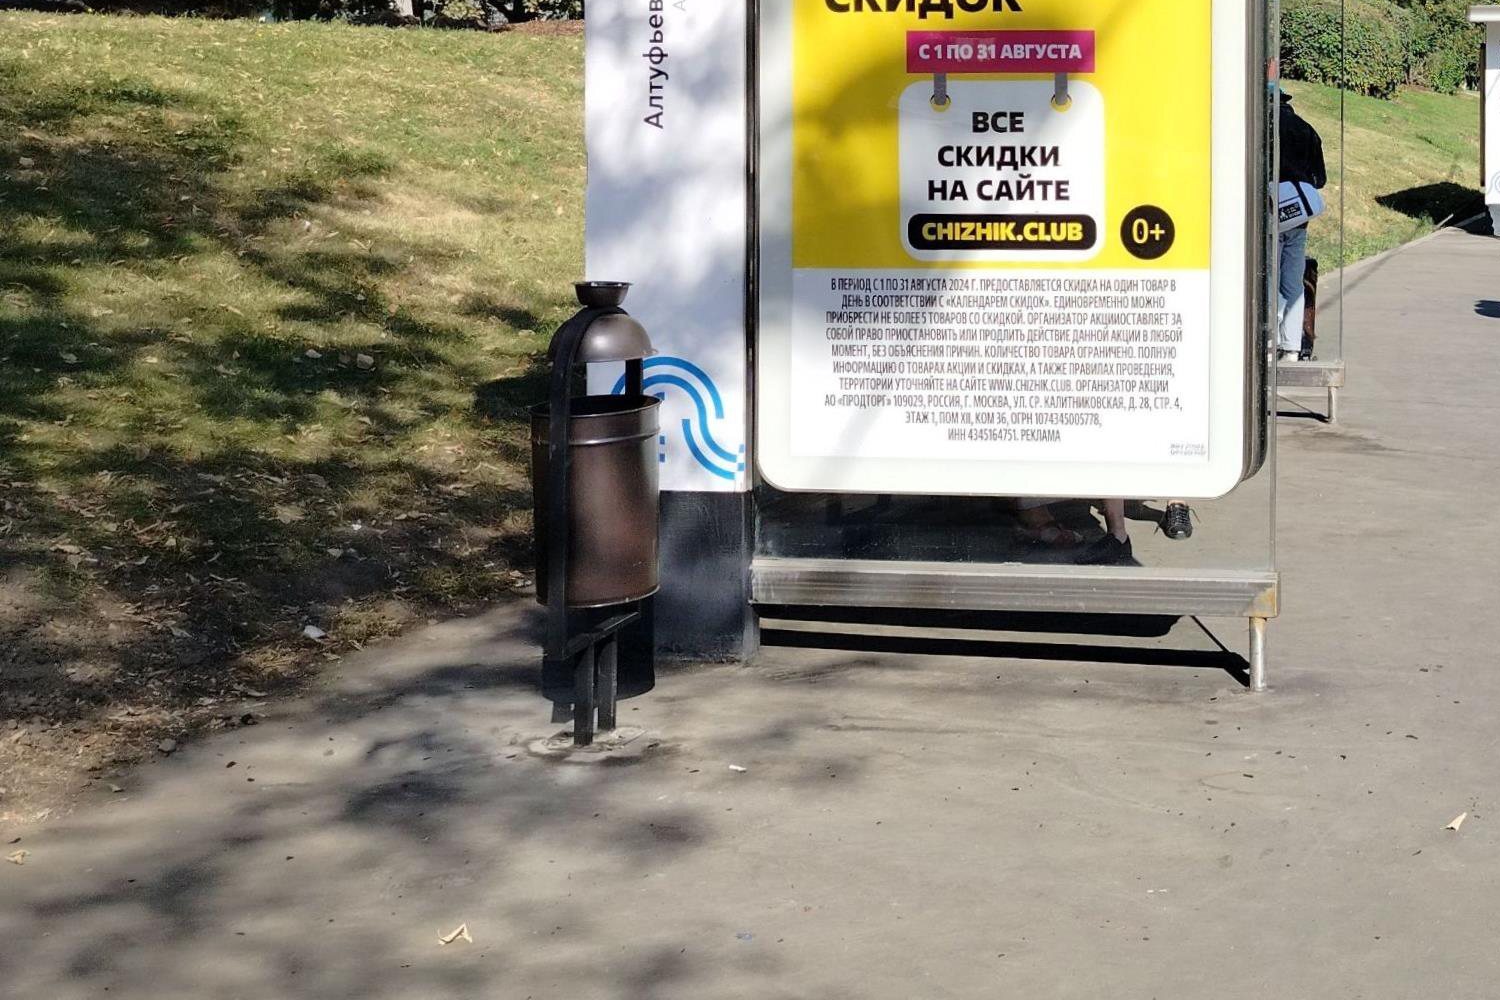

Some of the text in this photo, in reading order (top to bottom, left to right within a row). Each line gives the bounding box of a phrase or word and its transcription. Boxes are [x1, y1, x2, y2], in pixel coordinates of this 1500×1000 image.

[919, 43, 1082, 60] С 1 ПО 31 АВГУСТА
[972, 111, 1024, 133] ВСЕ
[937, 145, 1060, 170] СКИДКИ
[928, 175, 1070, 201] НА САЙТЕ
[921, 221, 1083, 241] CHIZHIK.CLUB
[1132, 218, 1165, 244] 0+
